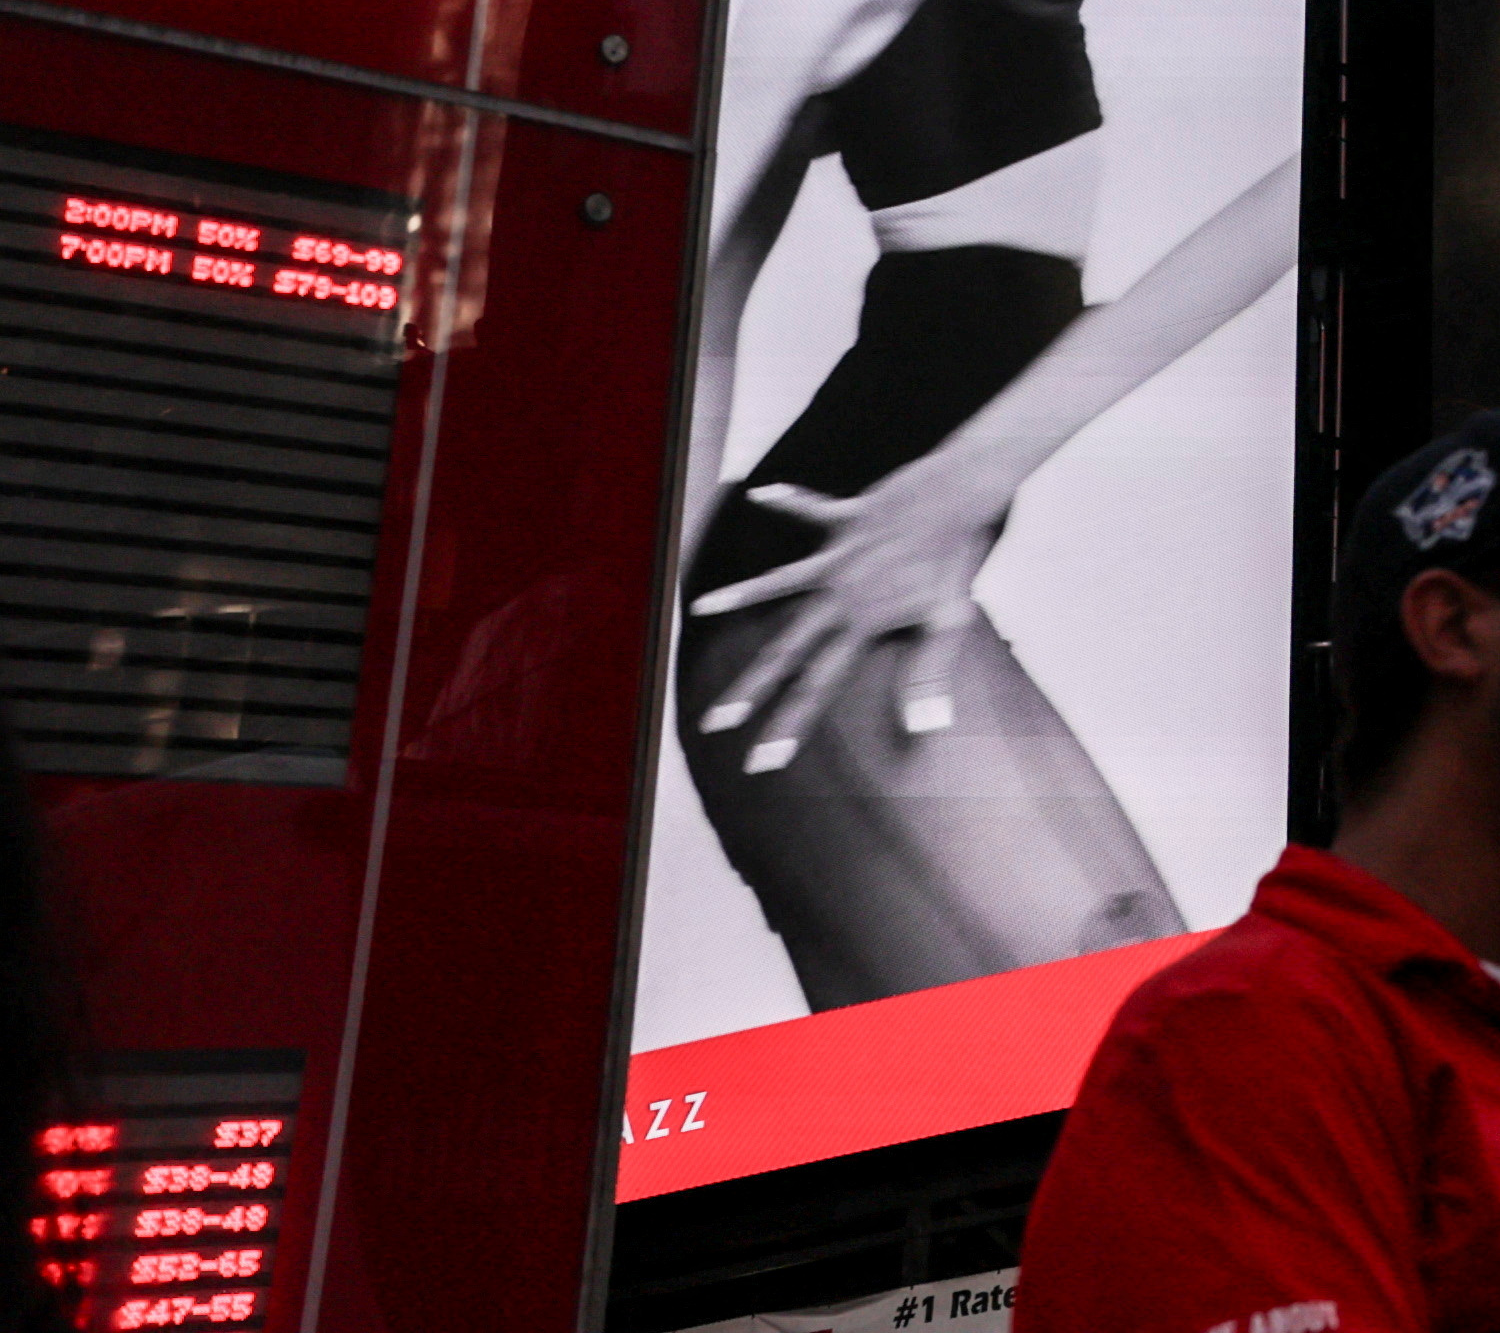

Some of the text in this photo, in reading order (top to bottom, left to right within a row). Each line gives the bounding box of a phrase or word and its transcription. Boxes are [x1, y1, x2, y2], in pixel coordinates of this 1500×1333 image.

[63, 197, 178, 239] 2:00PM
[197, 219, 261, 252] 50%
[192, 255, 255, 288] 50%
[893, 1295, 935, 1329] #1
